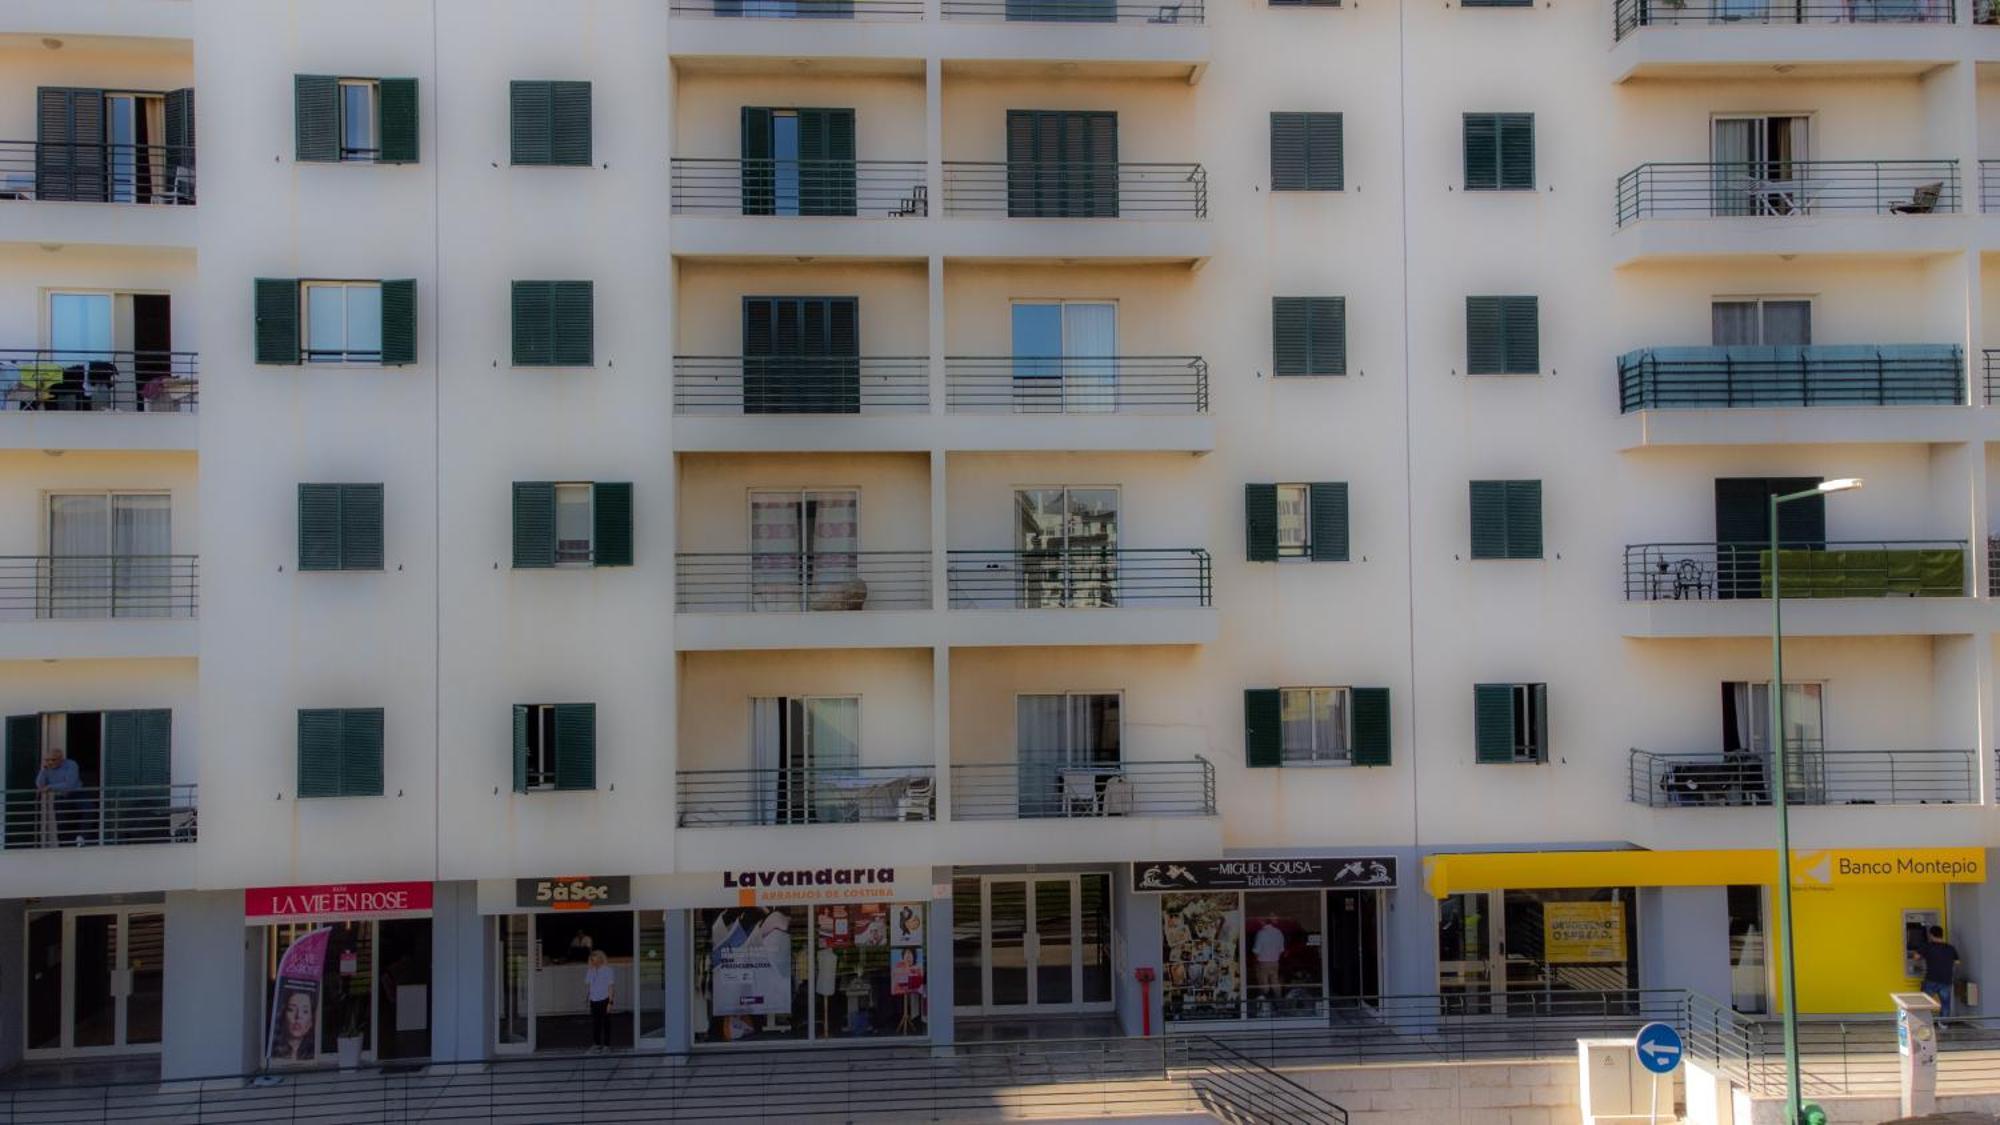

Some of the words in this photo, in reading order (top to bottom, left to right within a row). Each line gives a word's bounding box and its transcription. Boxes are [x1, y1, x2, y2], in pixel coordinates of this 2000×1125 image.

[1219, 862, 1265, 875] MIGUEL
[1269, 861, 1312, 873] SOUSA
[1839, 858, 1892, 875] Banco
[1897, 858, 1977, 877] Montepio
[723, 868, 895, 888] Lavandaria
[1247, 874, 1287, 887] Tattoo's
[825, 889, 841, 899] DE
[843, 887, 894, 898] COSTURA
[272, 896, 296, 914] LA
[300, 894, 330, 912] VIE
[333, 892, 358, 911] EN
[361, 891, 408, 910] ROSE
